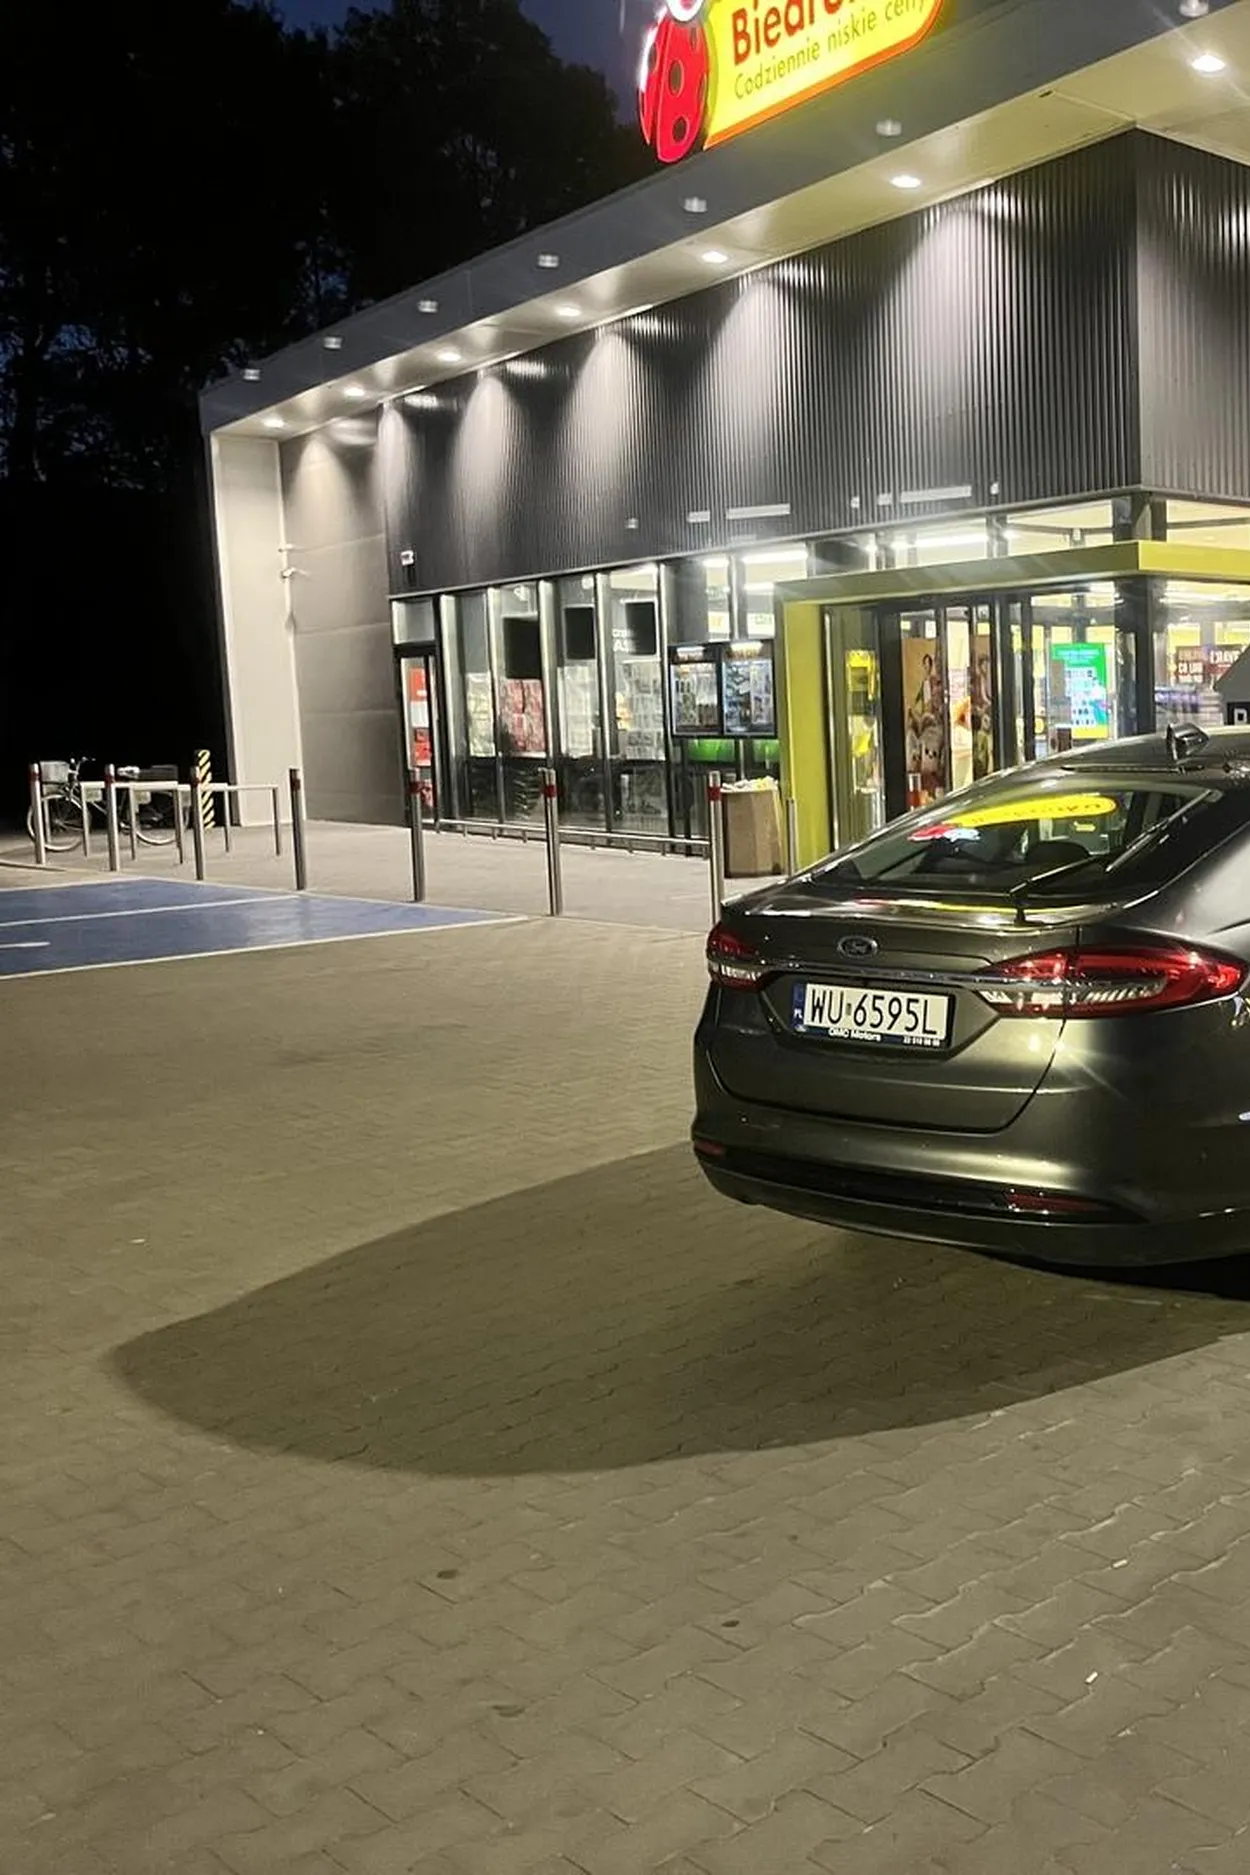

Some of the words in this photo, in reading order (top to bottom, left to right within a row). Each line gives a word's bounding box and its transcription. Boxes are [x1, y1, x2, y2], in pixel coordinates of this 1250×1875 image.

[734, 37, 820, 99] Codziennie
[828, 6, 877, 52] niskie
[810, 988, 844, 1025] WU
[853, 993, 938, 1036] 6595L
